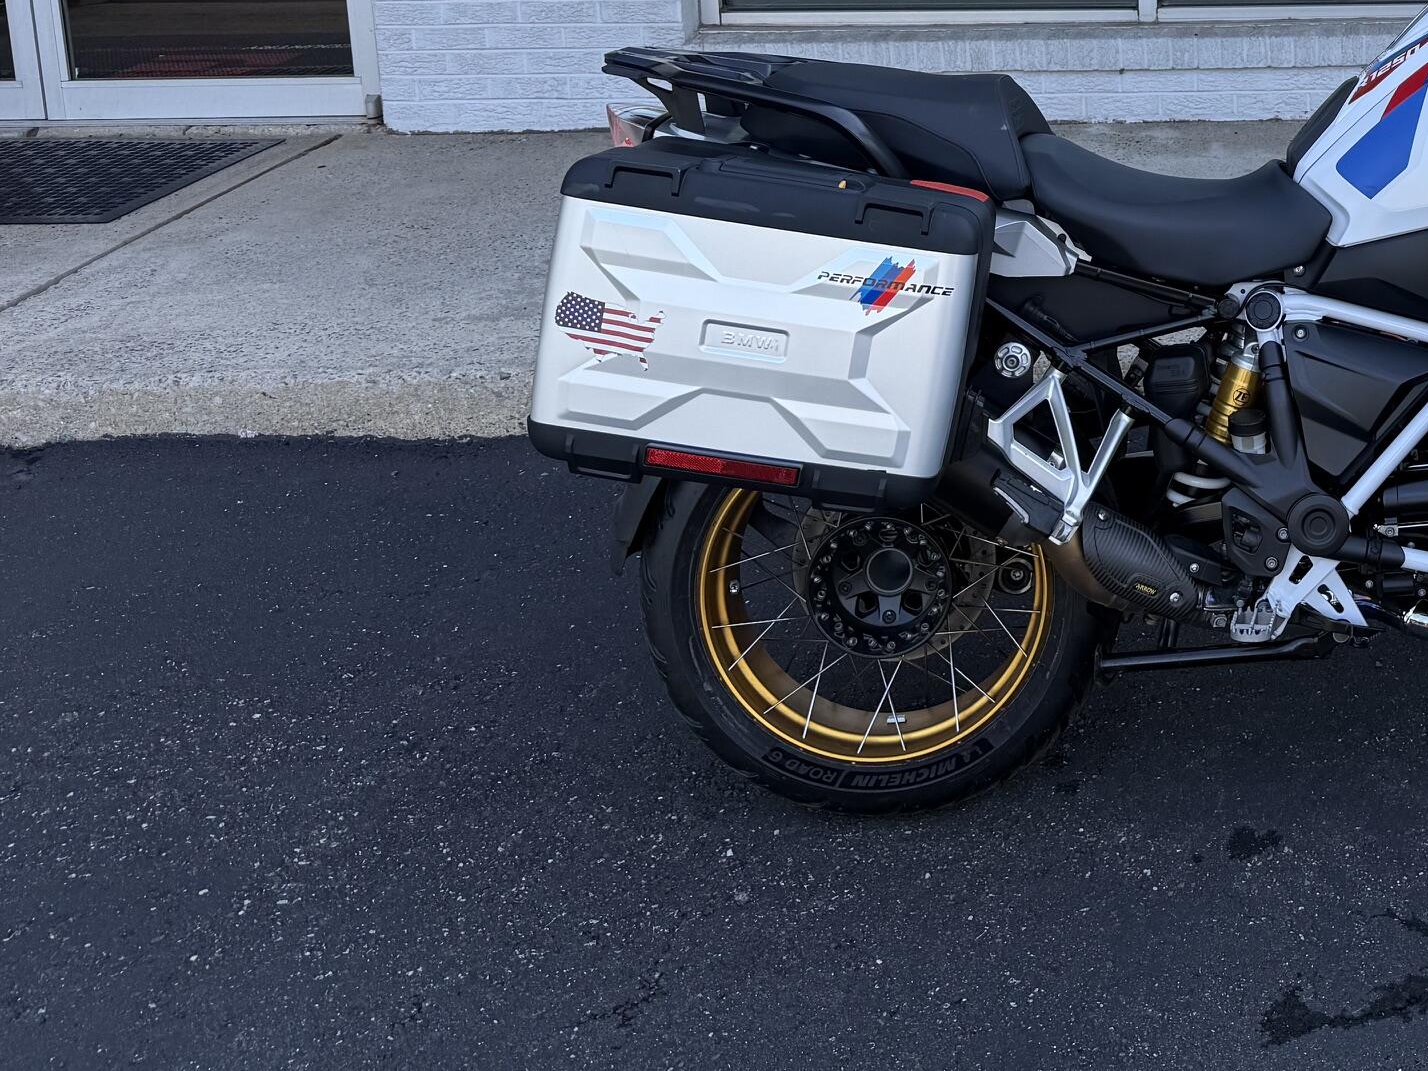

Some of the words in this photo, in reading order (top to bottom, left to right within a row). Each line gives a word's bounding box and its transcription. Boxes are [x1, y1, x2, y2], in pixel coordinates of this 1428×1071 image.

[817, 271, 955, 297] PERFORMANCE
[721, 331, 779, 352] BMW
[1234, 389, 1249, 403] ZF
[767, 751, 784, 763] 6
[785, 758, 839, 783] ROAD
[851, 759, 957, 787] MICHELIN
